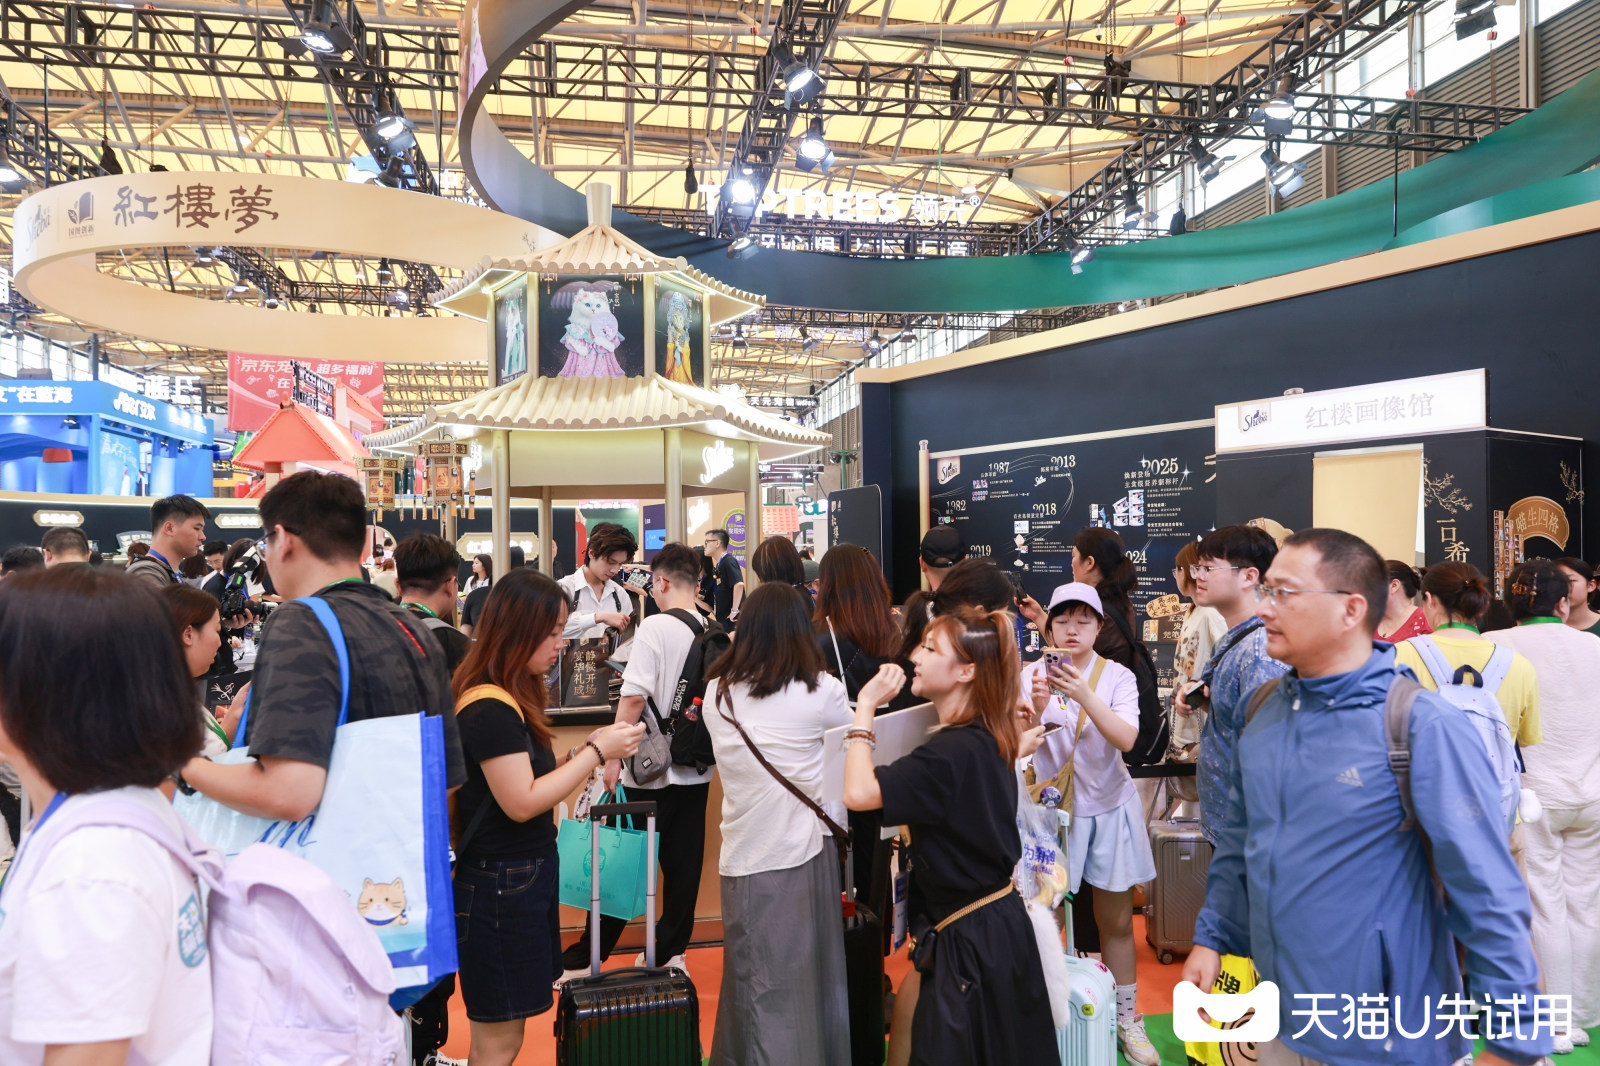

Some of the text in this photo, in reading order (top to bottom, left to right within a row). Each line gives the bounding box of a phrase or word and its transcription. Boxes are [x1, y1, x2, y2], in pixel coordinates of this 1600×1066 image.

[316, 363, 374, 376] 超多福利
[1304, 392, 1435, 430] 红楼画像馆
[989, 461, 1009, 474] 1987
[1050, 454, 1076, 468] 2013
[1141, 457, 1179, 475] 2025
[946, 499, 966, 511] 1982
[1032, 502, 1057, 516] 2018
[1515, 506, 1559, 535] 喵生四格
[970, 544, 992, 557] 2019
[1125, 550, 1147, 564] 024
